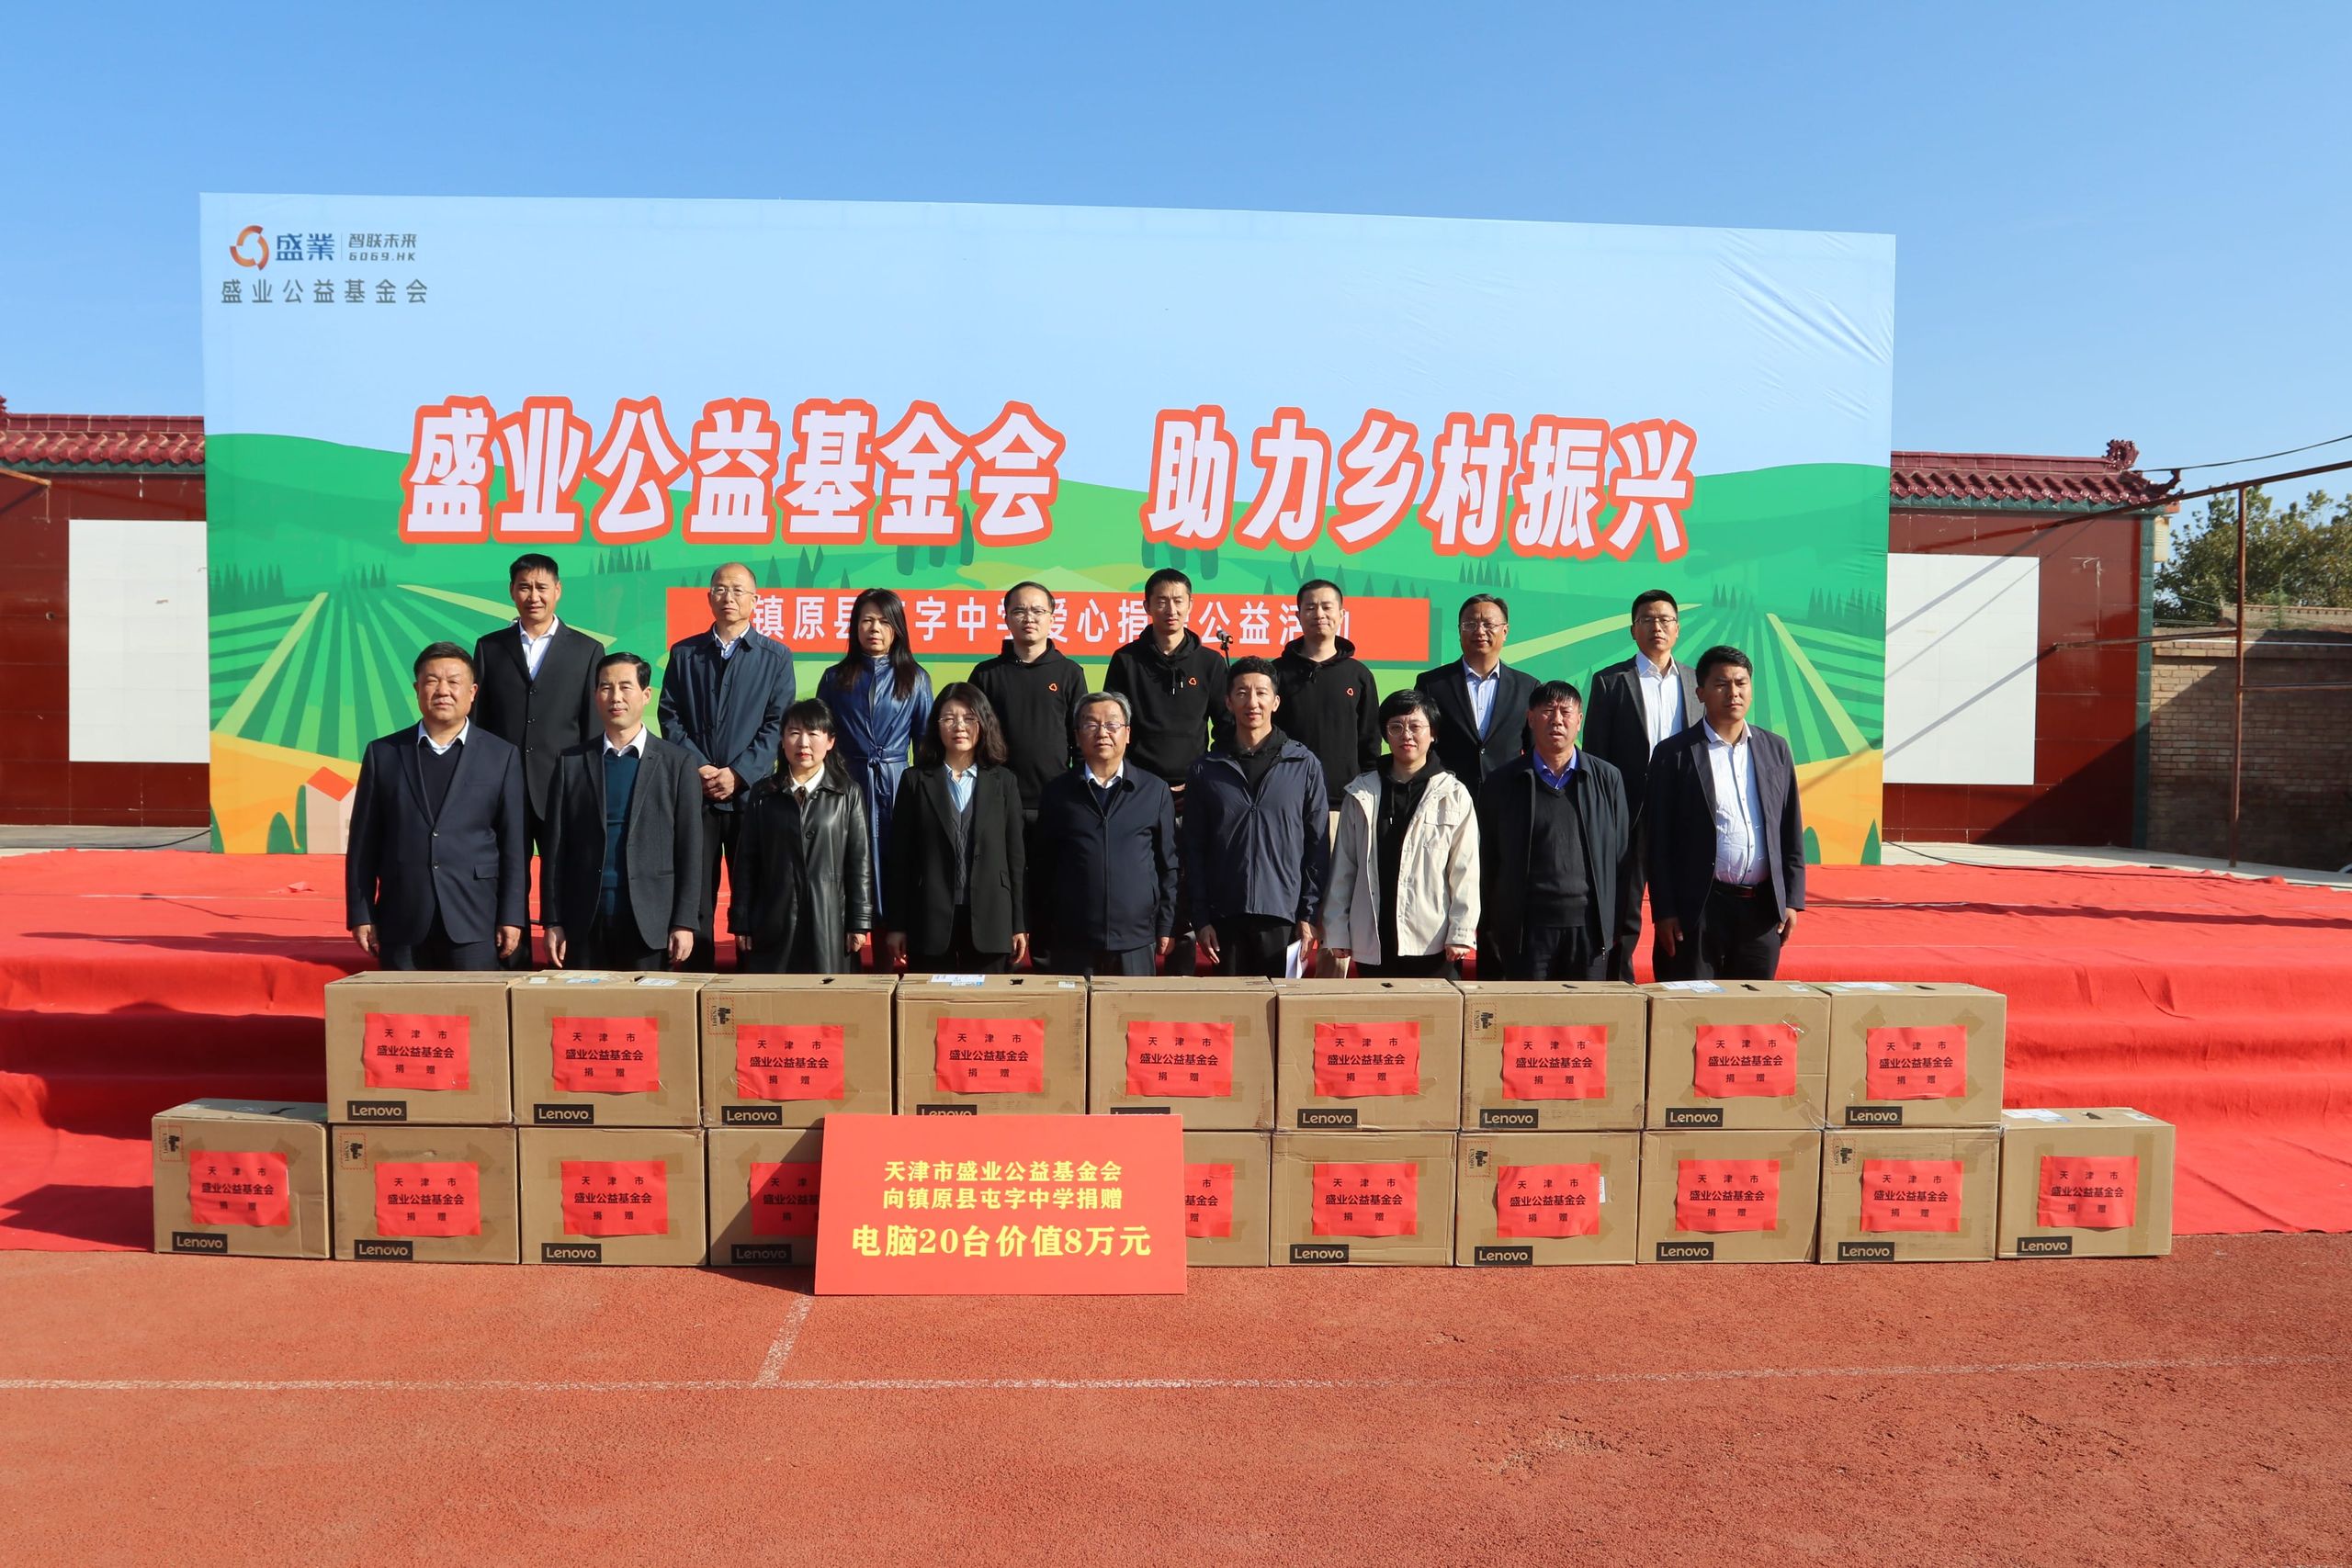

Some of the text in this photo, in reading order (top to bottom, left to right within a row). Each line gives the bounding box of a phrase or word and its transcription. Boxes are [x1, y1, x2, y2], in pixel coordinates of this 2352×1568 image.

[275, 232, 335, 262] 盛業
[348, 232, 417, 250] 智联未来
[348, 252, 417, 262] 6069.HK
[220, 277, 428, 304] 盛业公益基金会
[402, 401, 1692, 555] 盛业公益基金会 助力乡村振兴
[377, 1044, 455, 1059] 盛业公益基金会
[565, 1048, 644, 1061] 盛业公益基金会
[949, 1049, 1029, 1062] 盛业公益基金会
[749, 1055, 830, 1069] 盛业公益基金会
[1139, 1053, 1218, 1066] 盛业公益基金会
[1327, 1054, 1406, 1066] 盛业公益基金会
[1515, 1056, 1593, 1069] 盛业公益基金会
[1708, 1055, 1783, 1067] 盛业公益基金会
[1879, 1056, 1953, 1069] 盛业公益基金会
[352, 1104, 402, 1116] Lenovo
[538, 1108, 589, 1120] Lenovo
[726, 1110, 777, 1122] Lenovo
[1849, 1110, 1898, 1122] Lenovo
[1302, 1112, 1352, 1124] Lenovo
[1484, 1112, 1534, 1124] Lenovo
[1669, 1111, 1719, 1123] Lenovo
[883, 1160, 1124, 1182] 天津市盛业公益基金会
[201, 1181, 274, 1195] 盛业公益基金会
[2051, 1185, 2124, 1199] 盛业公益基金会
[387, 1193, 464, 1205] 盛业公益基金会
[573, 1191, 652, 1204] 盛业公益基金会
[882, 1188, 1124, 1211] 向镇原县屯字中学捐赠
[1325, 1193, 1403, 1205] 盛业公益基金会
[1510, 1194, 1587, 1207] 盛业公益基金会
[1690, 1190, 1765, 1201] 盛业公益基金会
[1873, 1190, 1949, 1202] 盛业公益基金会
[176, 1235, 223, 1249] Lenovo
[852, 1224, 1152, 1258] 电脑20台价值8万元
[2021, 1241, 2068, 1252] Lenovo
[358, 1243, 409, 1257] Lenovo
[546, 1247, 597, 1258] Lenovo
[736, 1247, 787, 1259] Lenovo
[1295, 1247, 1344, 1259] Lenovo
[1479, 1250, 1529, 1261] Lenovo
[1660, 1246, 1710, 1258] Lenovo
[1842, 1246, 1891, 1257] Lenovo
